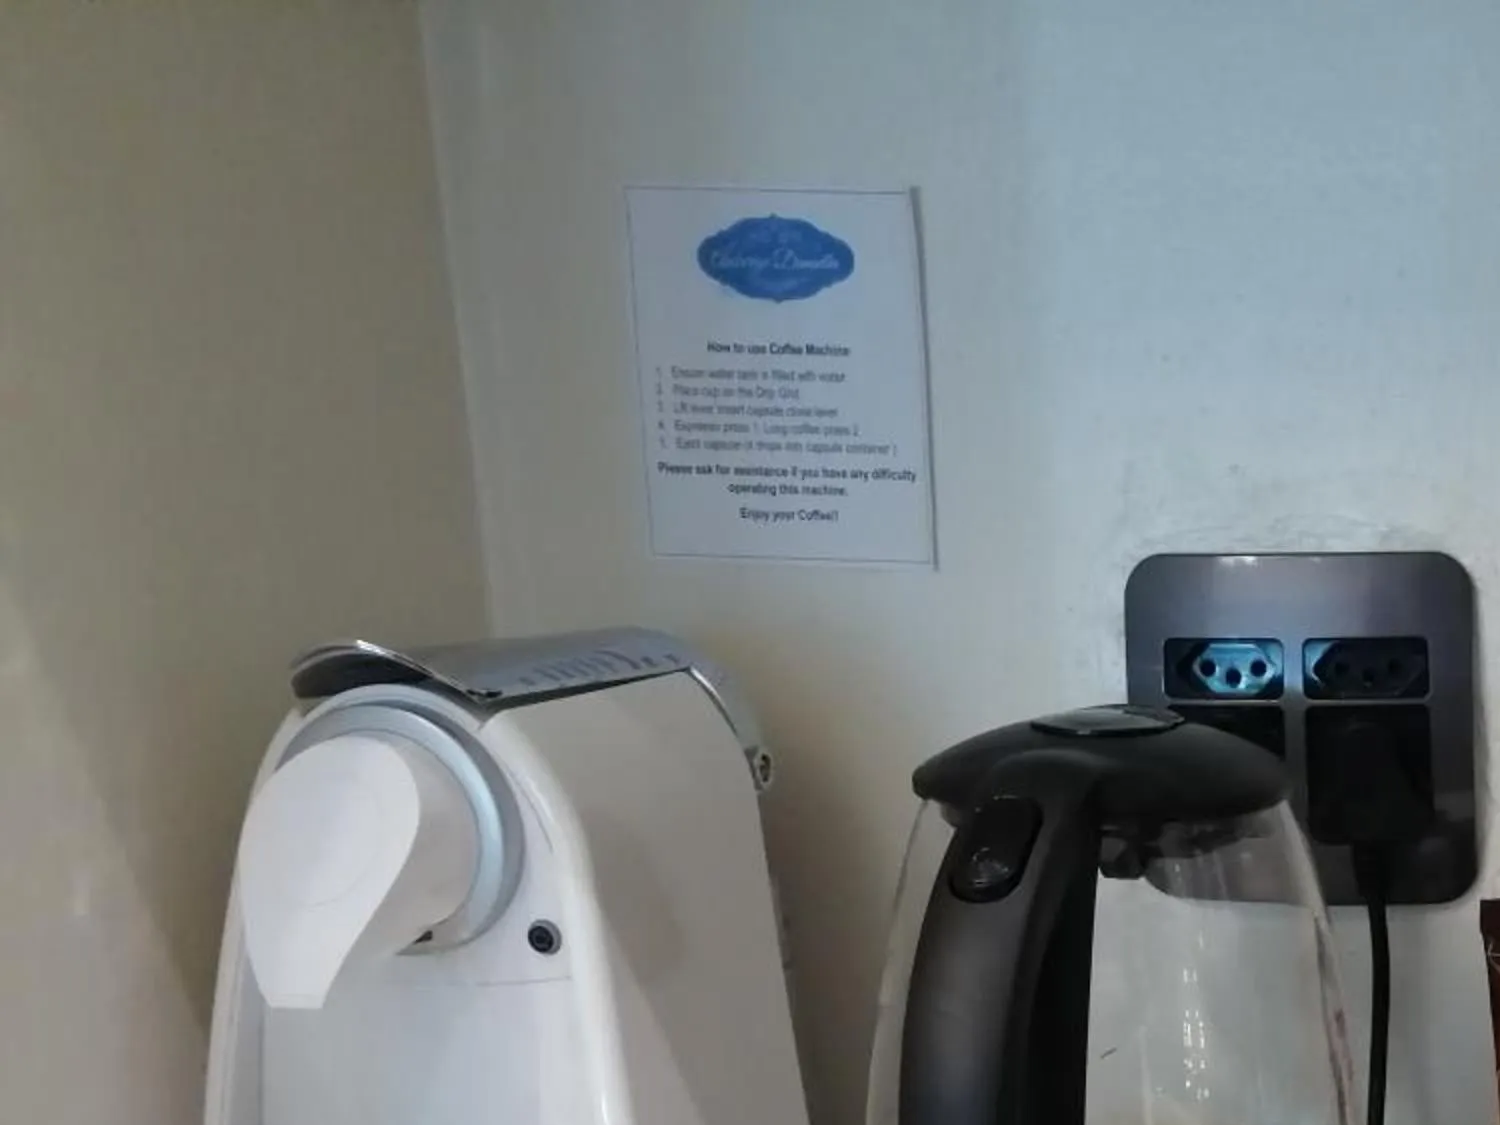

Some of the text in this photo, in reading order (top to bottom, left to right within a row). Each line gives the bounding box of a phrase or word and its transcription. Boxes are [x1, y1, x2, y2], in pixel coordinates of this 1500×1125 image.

[707, 342, 850, 357] How to use Coffee Machine
[657, 461, 693, 475] Please
[695, 464, 713, 475] ask
[715, 464, 731, 475] for
[734, 466, 788, 477] assistance
[800, 468, 819, 481] you
[821, 468, 847, 479] have
[849, 469, 869, 482] any
[871, 467, 916, 483] difficulty
[727, 483, 777, 497] operating
[779, 484, 799, 495] this
[739, 507, 769, 522] Enjoy
[772, 510, 795, 522] your
